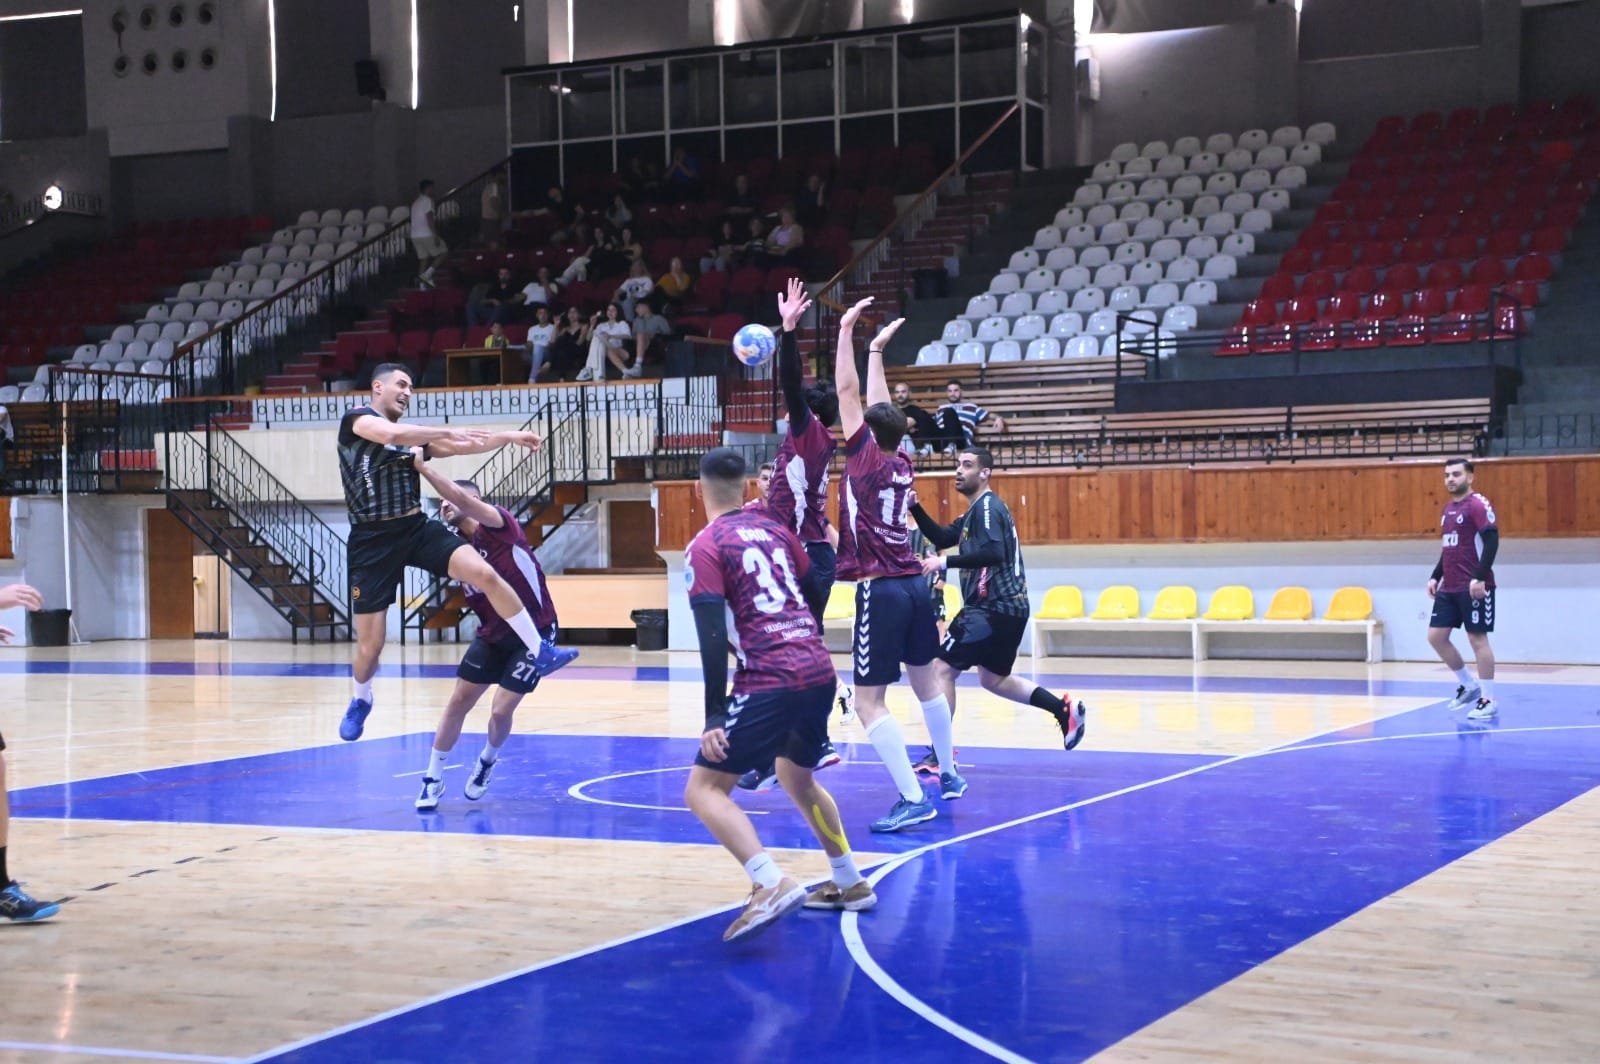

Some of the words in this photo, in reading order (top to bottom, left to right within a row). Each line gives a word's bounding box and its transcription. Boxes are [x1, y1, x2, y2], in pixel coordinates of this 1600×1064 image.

[742, 547, 806, 614] 31
[1471, 610, 1480, 624] 9
[511, 661, 536, 682] 27
